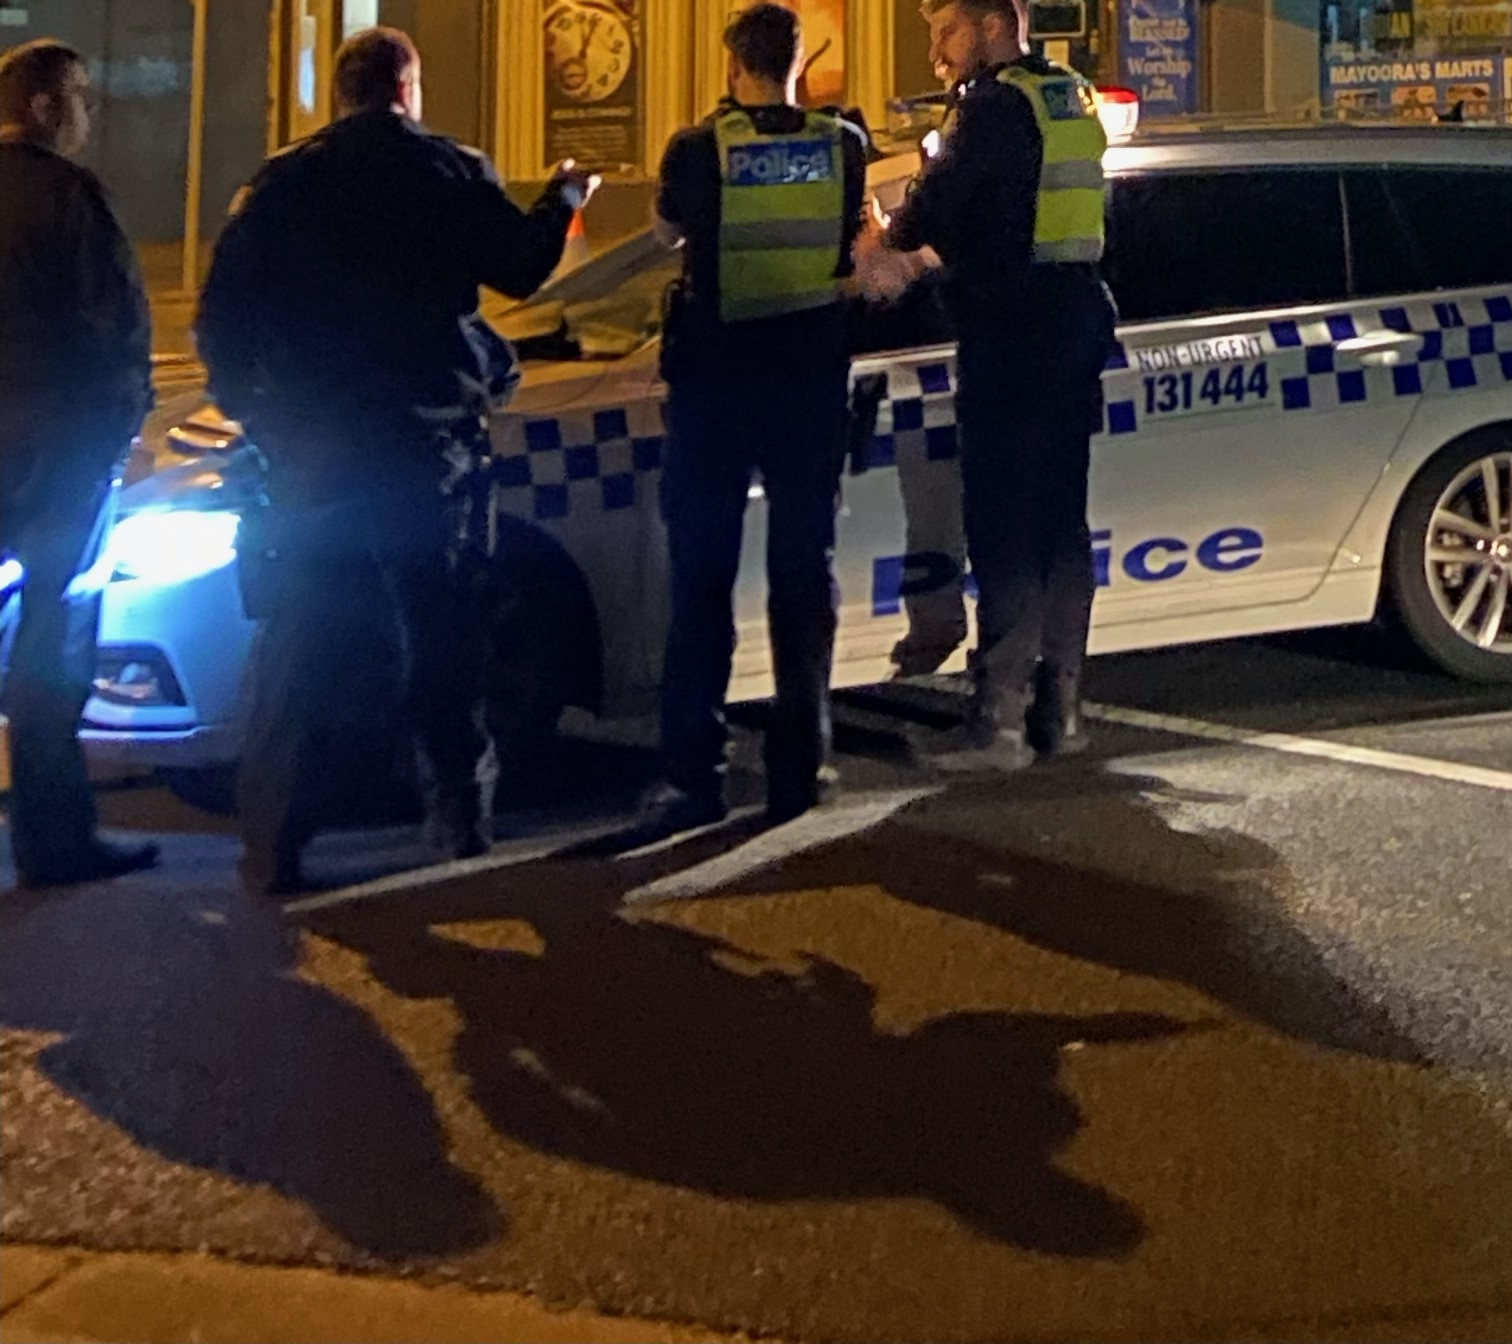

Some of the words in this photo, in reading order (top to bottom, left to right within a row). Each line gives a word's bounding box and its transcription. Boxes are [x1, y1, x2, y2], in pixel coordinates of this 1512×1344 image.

[1127, 57, 1192, 79] Worship
[1330, 63, 1431, 84] MAYOORA'S
[1435, 59, 1495, 80] MARTS
[729, 148, 830, 181] Police
[1136, 336, 1266, 371] NON-URGENT
[872, 526, 1264, 617] Pice
